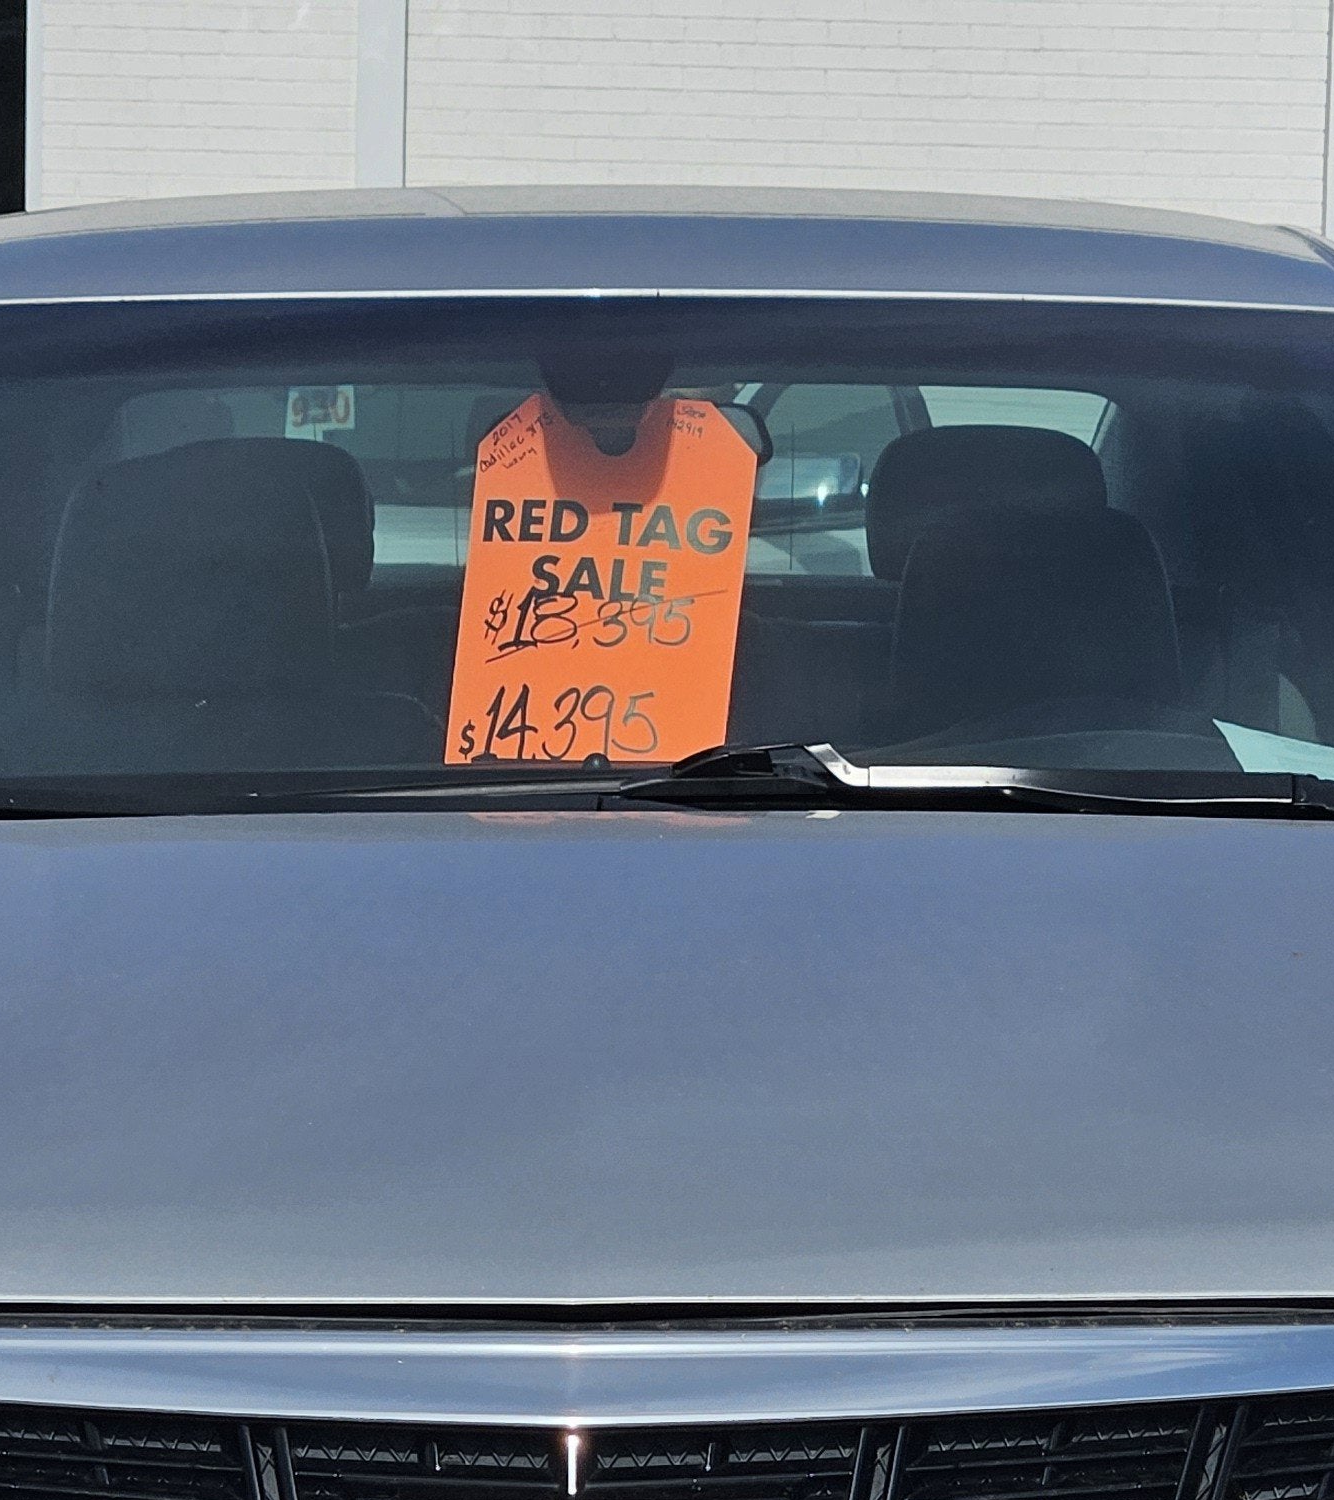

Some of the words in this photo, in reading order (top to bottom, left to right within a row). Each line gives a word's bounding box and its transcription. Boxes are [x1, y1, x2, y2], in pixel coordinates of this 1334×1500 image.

[492, 412, 522, 446] 2017
[482, 498, 589, 543] RED
[612, 502, 734, 555] TAG
[531, 554, 668, 603] SALE
